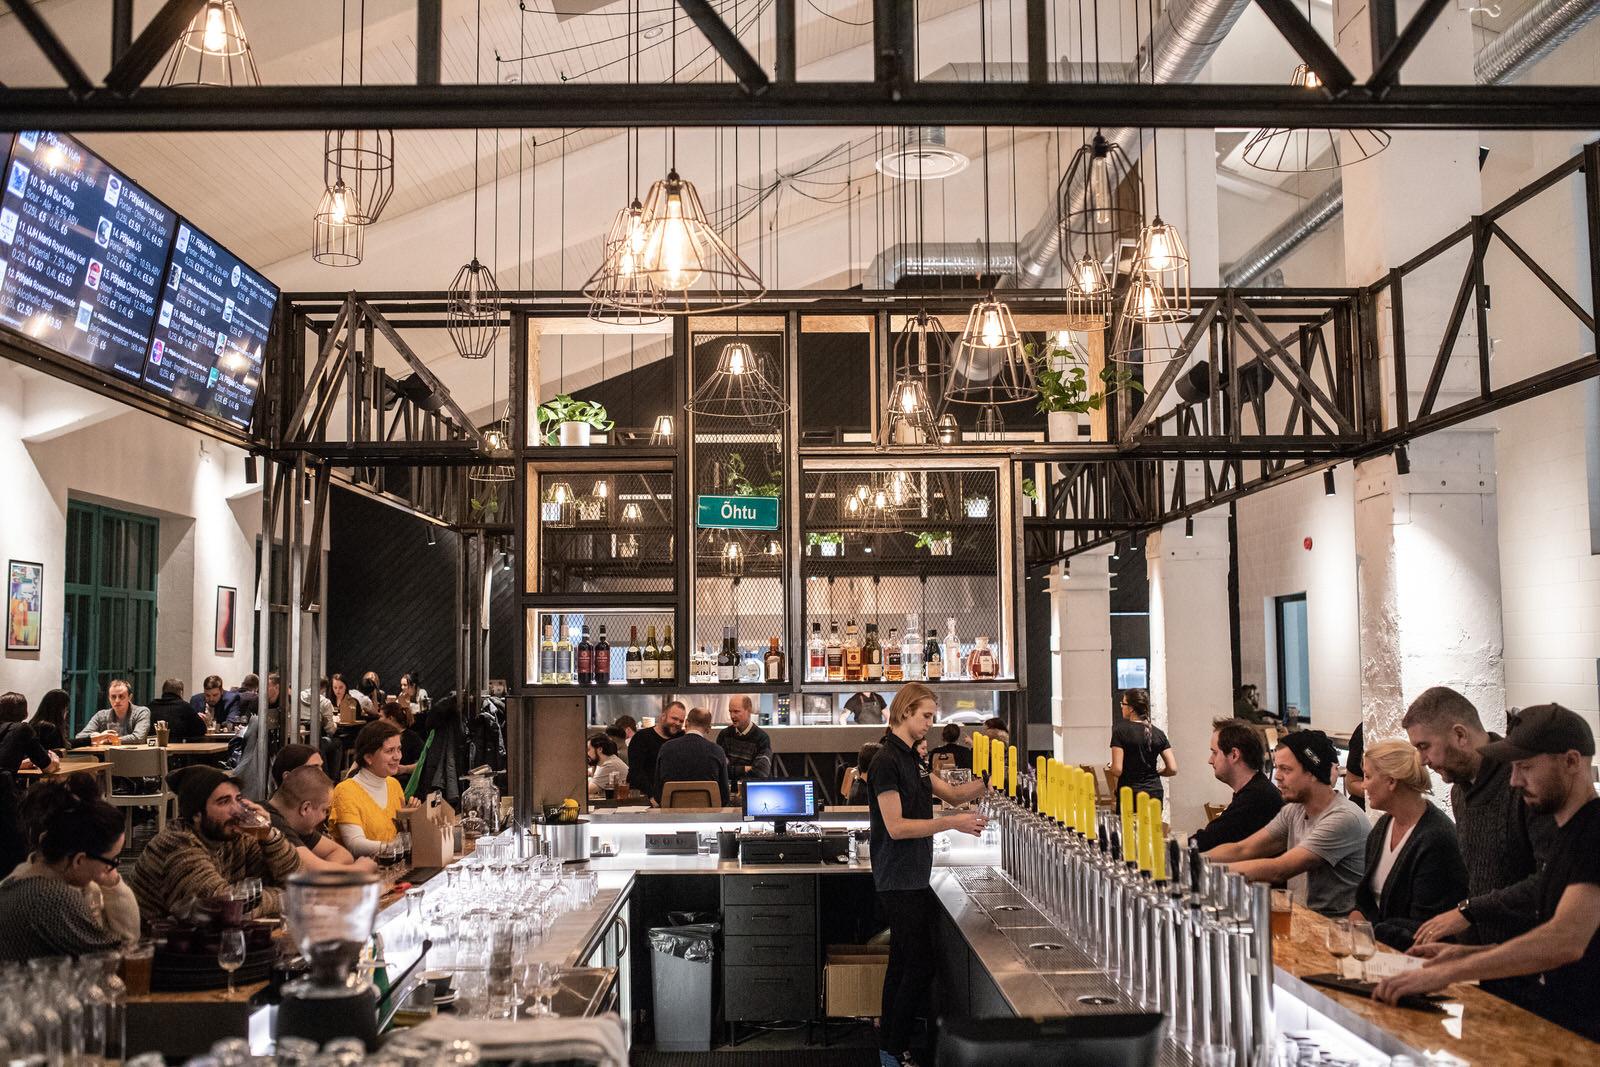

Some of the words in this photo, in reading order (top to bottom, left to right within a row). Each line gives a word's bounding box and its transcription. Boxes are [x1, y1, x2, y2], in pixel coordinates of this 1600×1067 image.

[30, 174, 40, 188] 10.
[38, 180, 47, 193] To
[52, 189, 63, 203] Sur
[62, 195, 75, 211] Citra
[70, 180, 79, 193] €5
[121, 185, 129, 198] 13.
[26, 188, 40, 204] Sour
[42, 198, 52, 212] Ale
[67, 213, 79, 228] ABV
[38, 210, 47, 223] €5
[60, 223, 69, 236] €6
[118, 198, 133, 214] Porter
[158, 225, 167, 238] ABV
[18, 220, 28, 233] 11.
[51, 238, 66, 256] Royal
[112, 226, 120, 239] 14.
[14, 234, 26, 248] IPA
[28, 241, 51, 263] Imperial
[52, 255, 66, 270] 7.5%
[65, 262, 77, 275] ABV
[109, 239, 123, 255] Porter
[124, 249, 138, 264] Baltic
[151, 265, 161, 278] ABV
[27, 256, 44, 273] €4.50
[57, 272, 73, 288] €5.50
[102, 268, 111, 280] 15.
[7, 268, 16, 280] 12.
[31, 280, 55, 300] Rosemary
[54, 291, 76, 309] Lemonade
[99, 281, 113, 295] Stout
[113, 289, 132, 307] Imperial
[145, 306, 155, 318] ABV
[16, 301, 34, 318] €2.50
[41, 298, 54, 312] Beer
[721, 501, 757, 519] Õhtu
